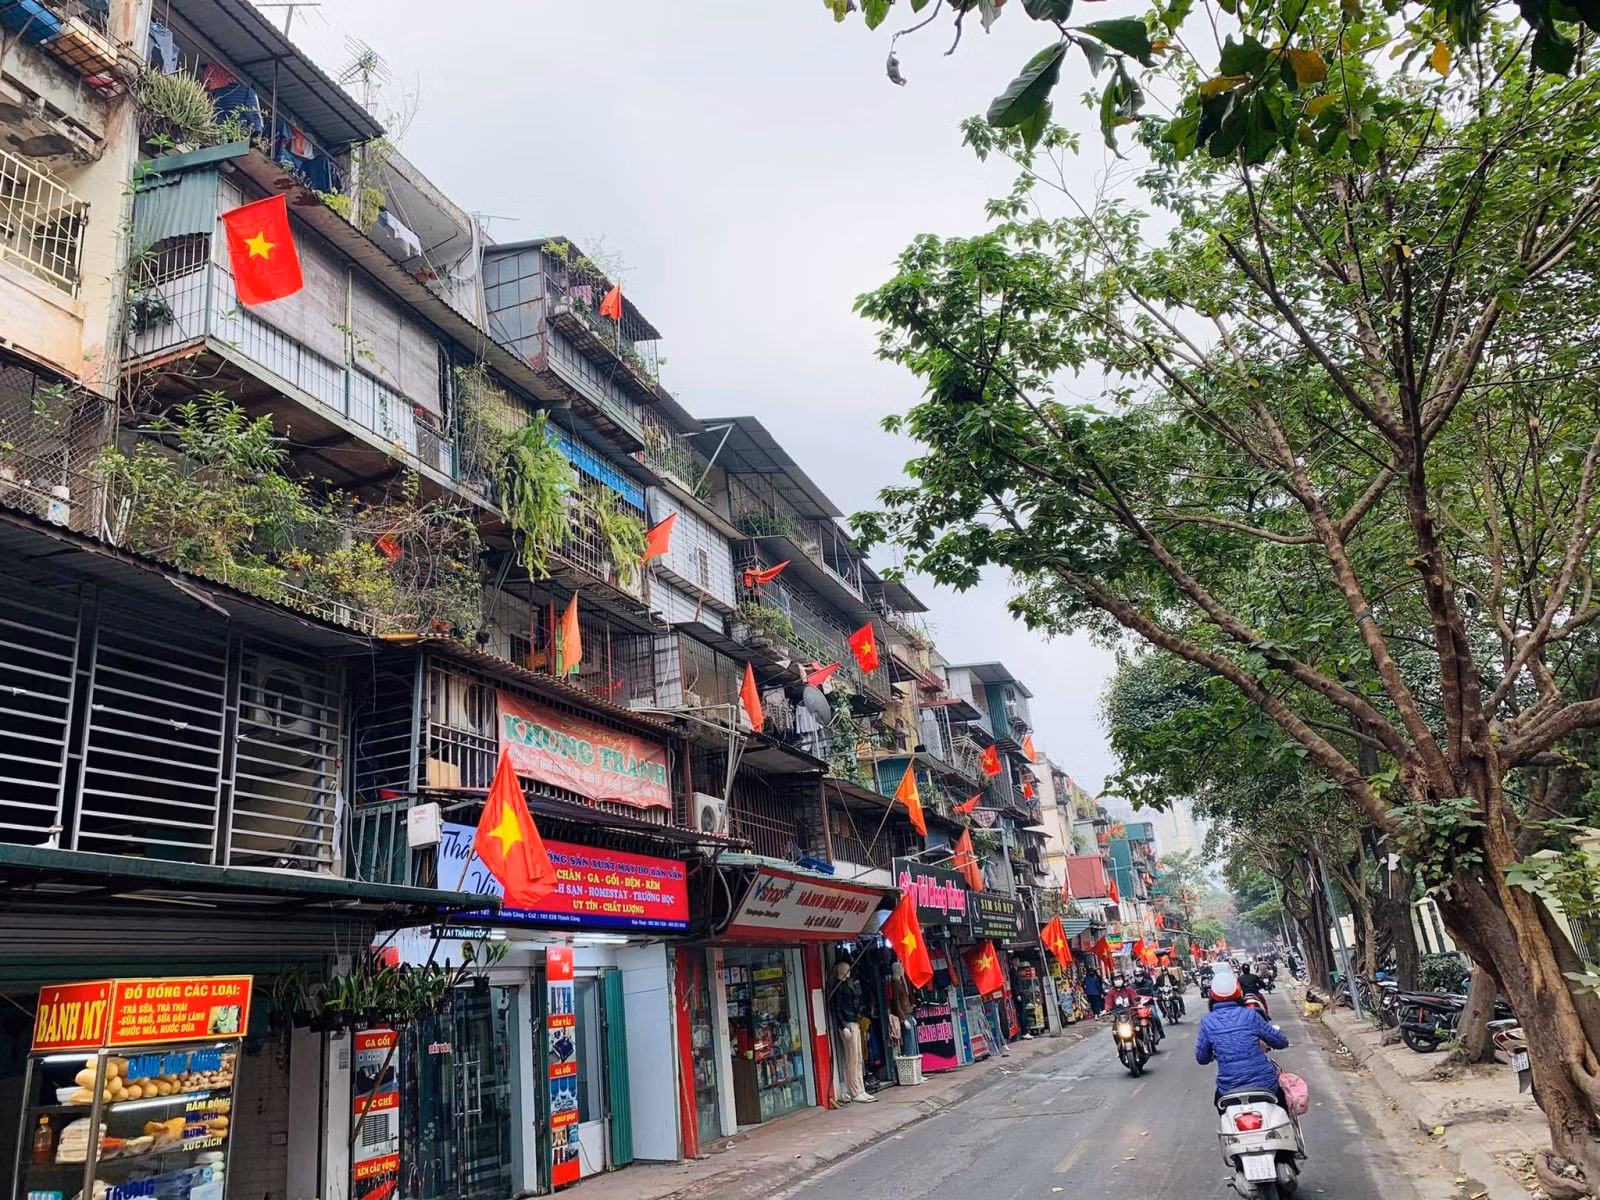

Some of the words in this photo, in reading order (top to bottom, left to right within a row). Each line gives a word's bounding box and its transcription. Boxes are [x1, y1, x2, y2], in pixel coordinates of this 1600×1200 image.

[503, 713, 594, 765] KHUNG
[556, 868, 581, 881] CHĂN
[587, 872, 600, 884] GA
[605, 873, 620, 885] GỐI
[566, 885, 583, 897] SẠN
[589, 887, 628, 899] HOMESTAY
[573, 900, 584, 910] UY
[585, 900, 598, 911] TÍN
[603, 901, 621, 913] CHẤT
[454, 927, 475, 939] THÀNH
[124, 984, 143, 1000] ĐỒ
[146, 984, 181, 998] UỐNG
[184, 983, 209, 997] CÁC
[211, 983, 241, 999] LOẠI:
[157, 1003, 171, 1012] TRÀ
[36, 992, 82, 1043] BÁNH
[365, 1039, 376, 1047] GA
[377, 1035, 390, 1046] GỐI
[378, 1094, 393, 1107] GHẾ
